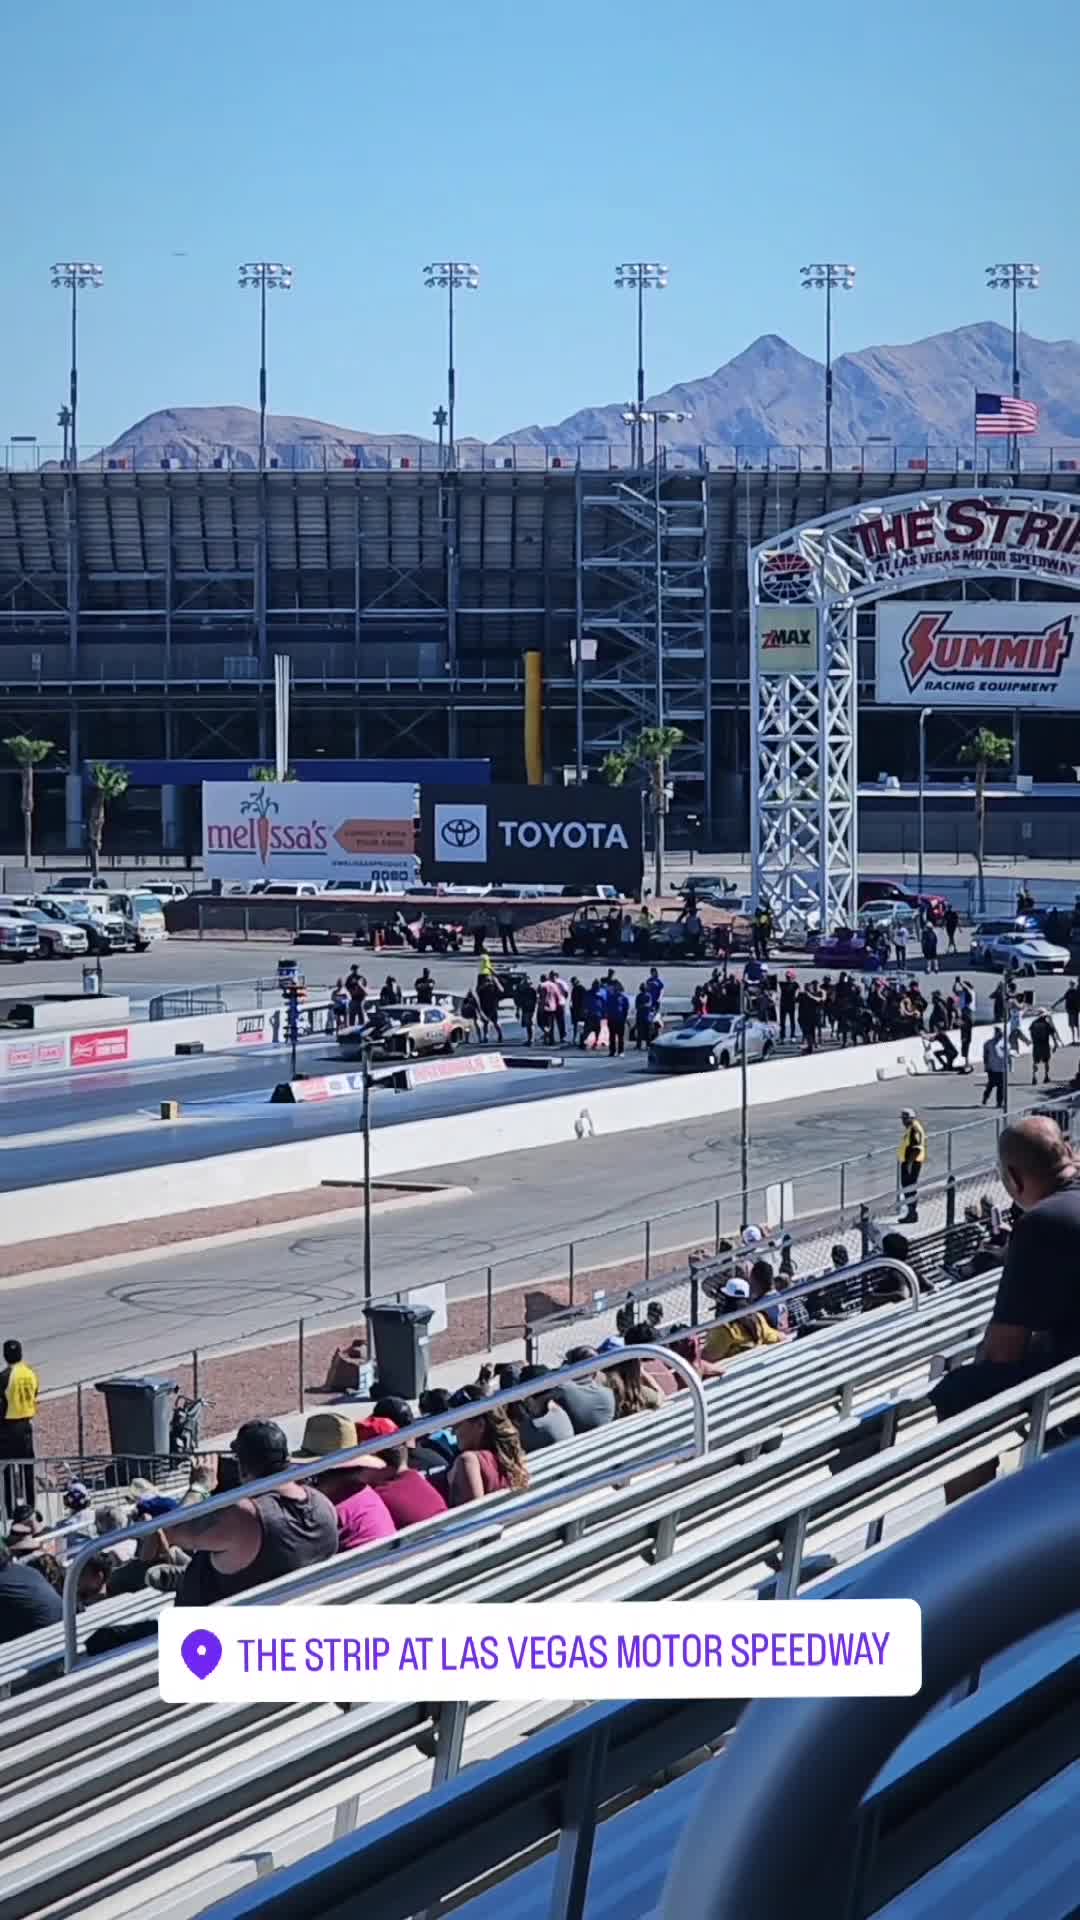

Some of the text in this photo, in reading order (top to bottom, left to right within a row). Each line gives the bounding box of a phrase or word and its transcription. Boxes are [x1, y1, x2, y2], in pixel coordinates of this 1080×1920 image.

[851, 509, 936, 559] THE
[876, 550, 1077, 575] AT LAS VEGAS MOTOR SPEEDWAY
[924, 681, 1059, 693] RACING EQUIPMENT
[498, 821, 629, 849] TOYOTA
